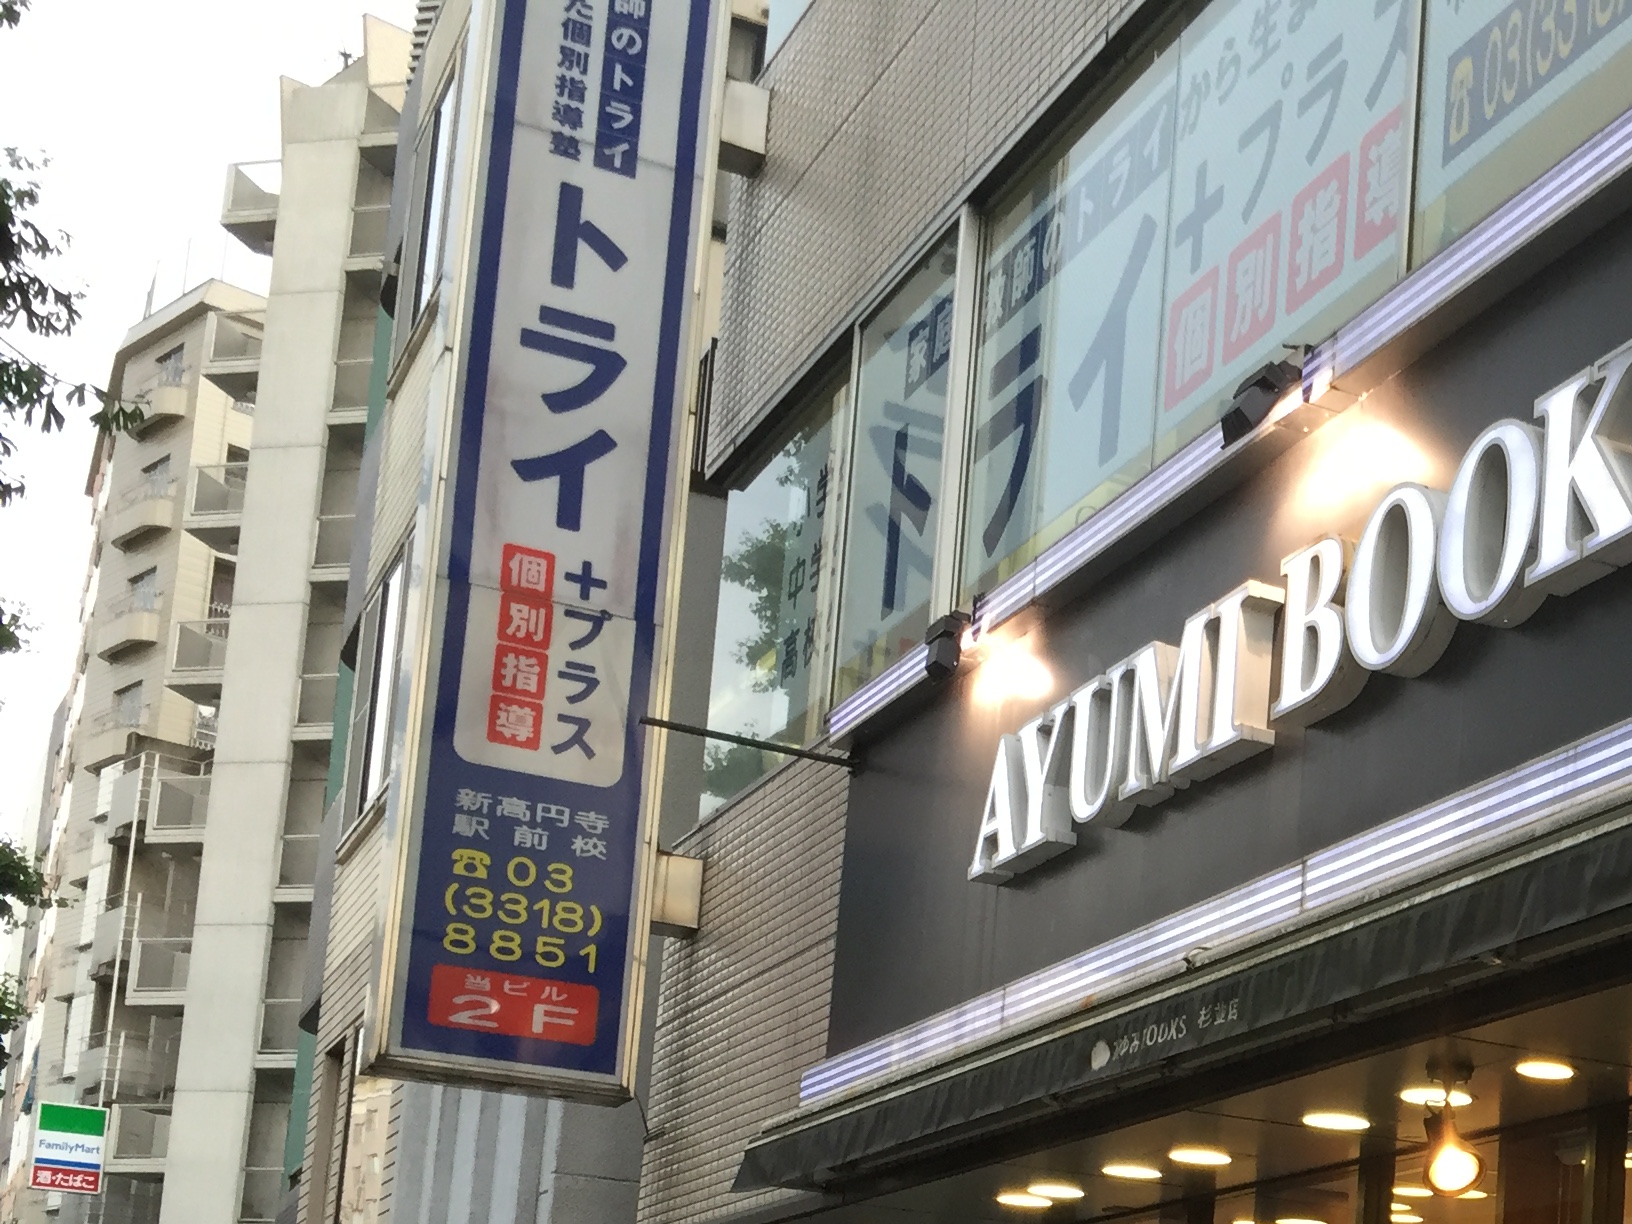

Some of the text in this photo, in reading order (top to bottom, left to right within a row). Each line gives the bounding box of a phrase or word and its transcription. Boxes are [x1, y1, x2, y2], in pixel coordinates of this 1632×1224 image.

[510, 180, 629, 533] トライ
[494, 549, 551, 747] 個別指導
[967, 580, 1278, 882] AYUMI
[454, 787, 611, 832] 新高円寺
[452, 815, 608, 861] 駅前校
[506, 855, 574, 894] 03
[444, 883, 603, 937] (3318)
[443, 923, 599, 973] 8851
[464, 973, 568, 1000] 当ビル
[38, 1139, 101, 1155] FamilyMart
